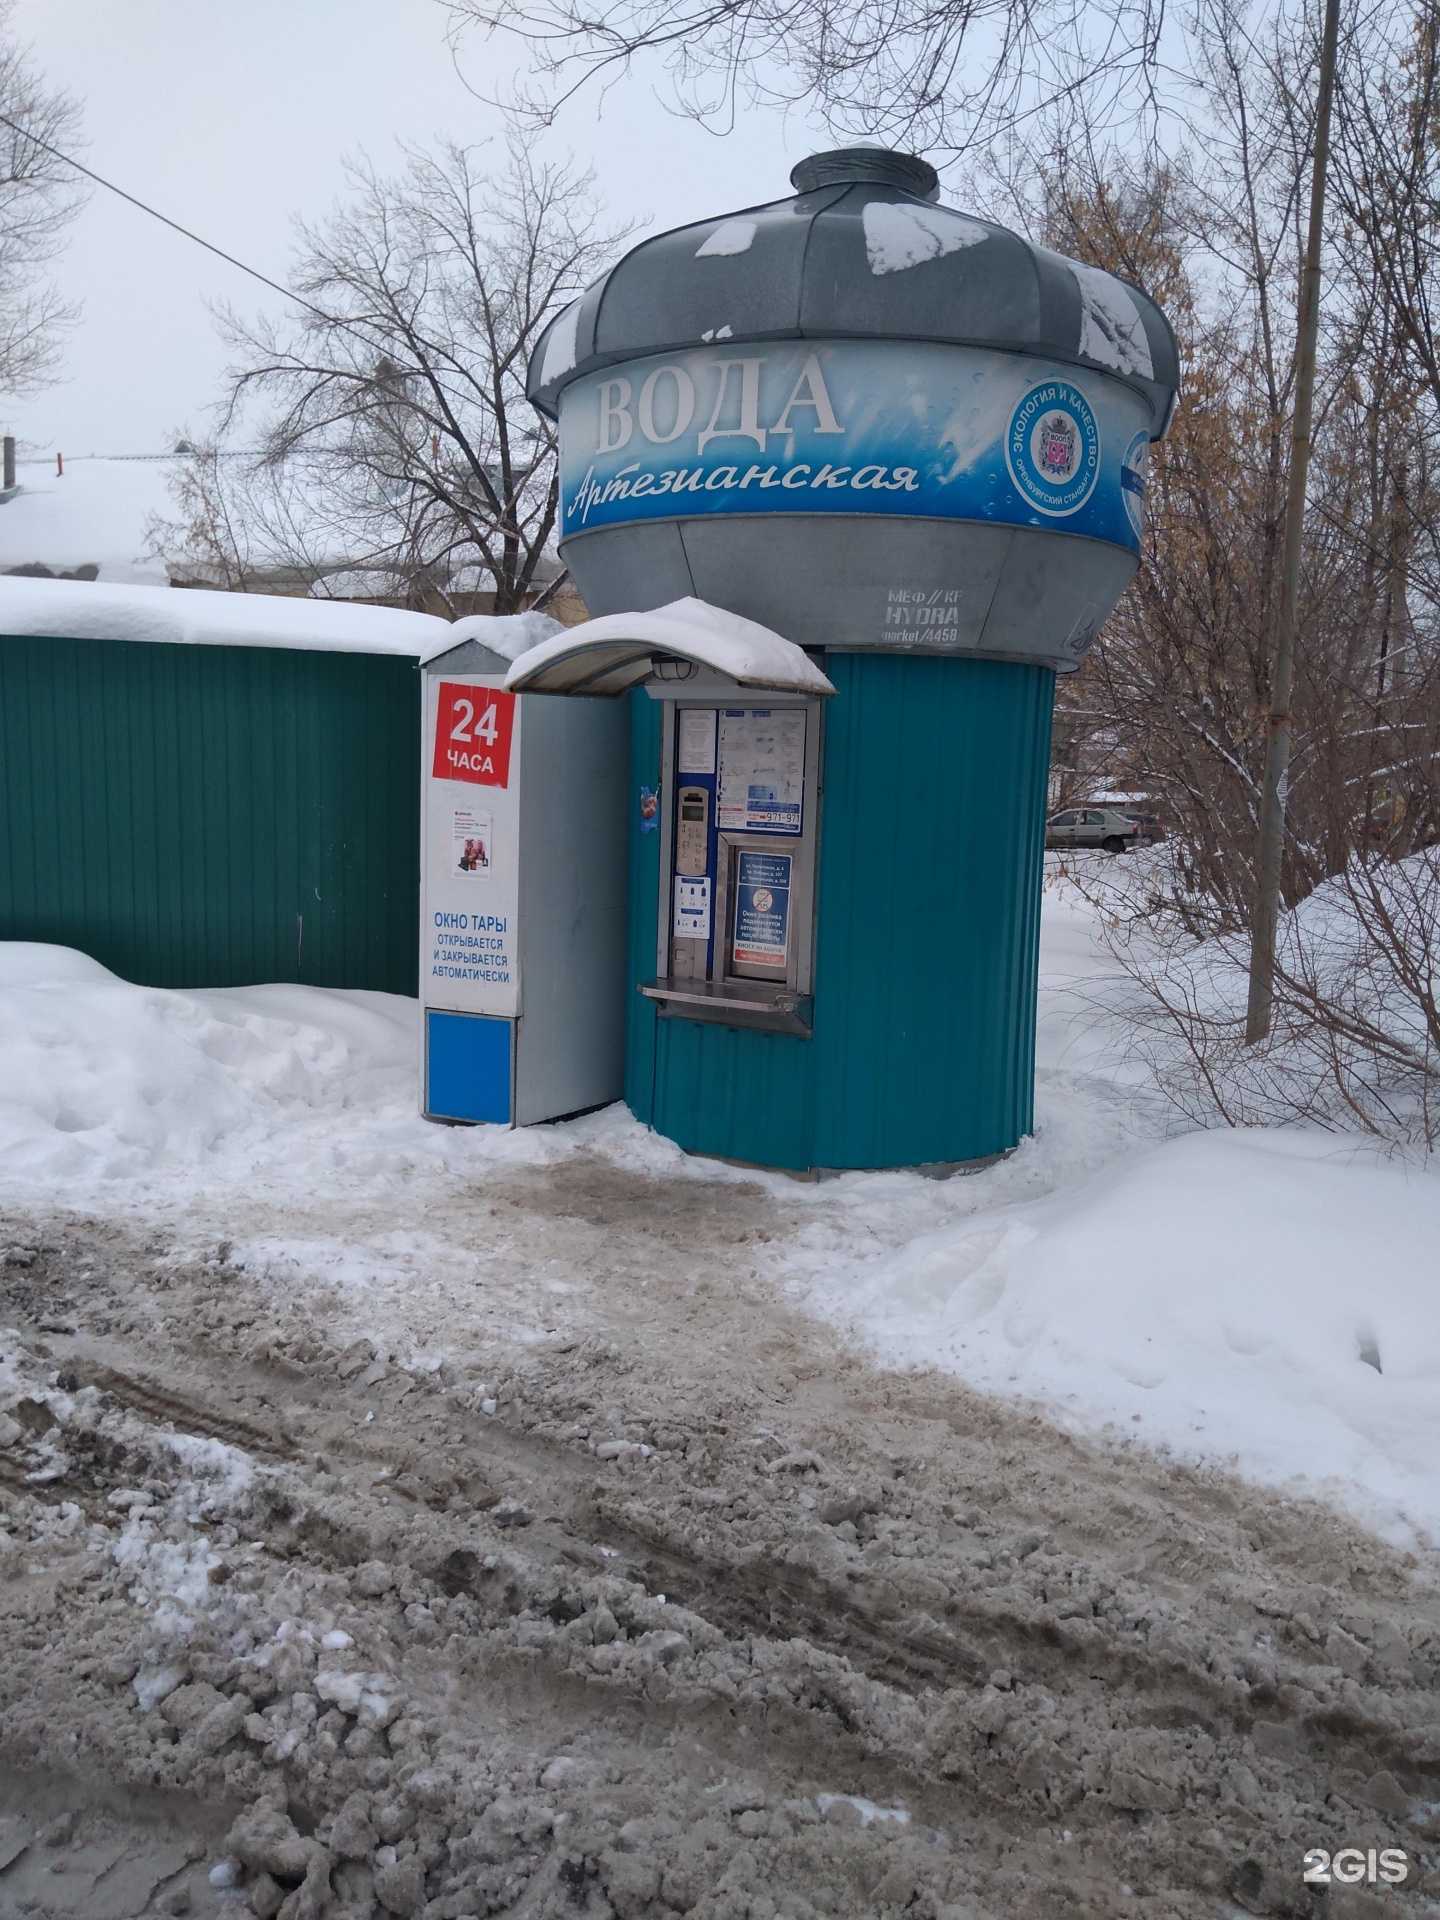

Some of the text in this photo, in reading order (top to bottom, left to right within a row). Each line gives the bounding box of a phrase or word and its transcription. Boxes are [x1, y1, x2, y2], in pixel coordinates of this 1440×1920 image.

[596, 353, 846, 456] ВОДА
[1013, 387, 1097, 467] ЭКОЛОГИЯ И КАЧЕСТВО
[567, 463, 919, 524] Артезианская
[1063, 471, 1091, 504] СТАНДАРТ
[885, 606, 959, 625] HYDRA
[450, 698, 498, 747] 24
[447, 749, 494, 774] ЧАСА
[434, 911, 507, 932] ОКНО ТАРЫ
[437, 933, 503, 950] ОТКРЫВАЕТСЯ
[433, 949, 508, 966] И ЗАКРЫВАЕТСЯ
[431, 965, 510, 983] АВТОМАТИЧЕСКИ
